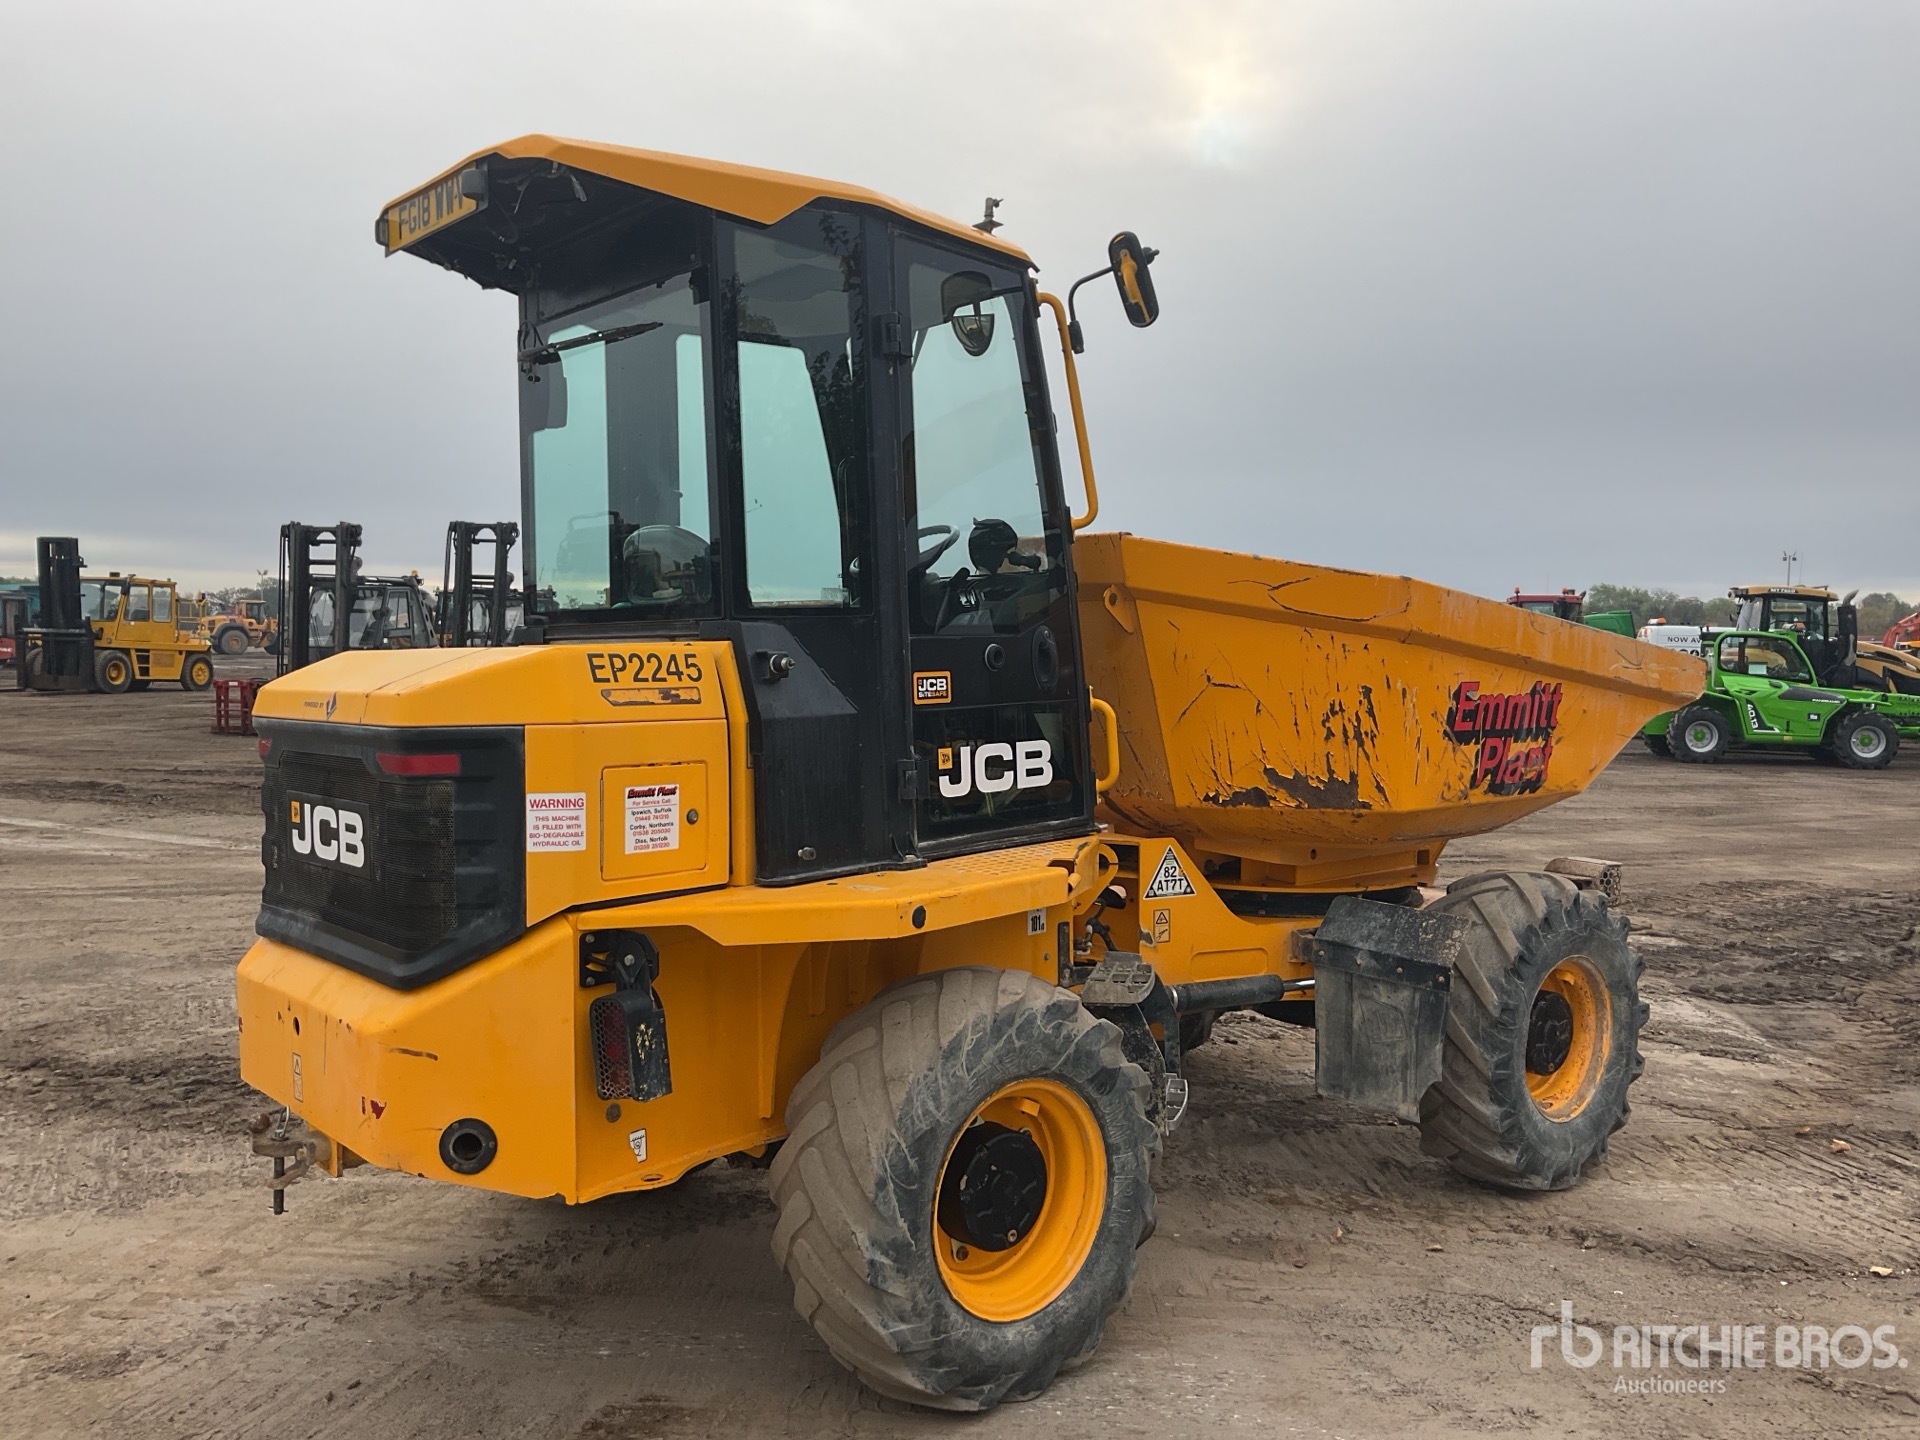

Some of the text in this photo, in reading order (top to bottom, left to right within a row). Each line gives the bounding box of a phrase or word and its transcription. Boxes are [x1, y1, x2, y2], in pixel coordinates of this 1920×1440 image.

[586, 652, 703, 684] EP2245
[918, 678, 948, 691] JCB
[1447, 681, 1563, 742] Emmitt
[1747, 703, 1759, 729] 40.13
[938, 739, 1053, 798] JCB
[1472, 735, 1553, 792] Plant
[529, 797, 585, 809] WARNING
[627, 786, 678, 799] Emmitt Plant
[291, 802, 365, 868] JCB
[529, 830, 585, 839] BIO-DEGRADABLE
[1163, 865, 1177, 879] 82
